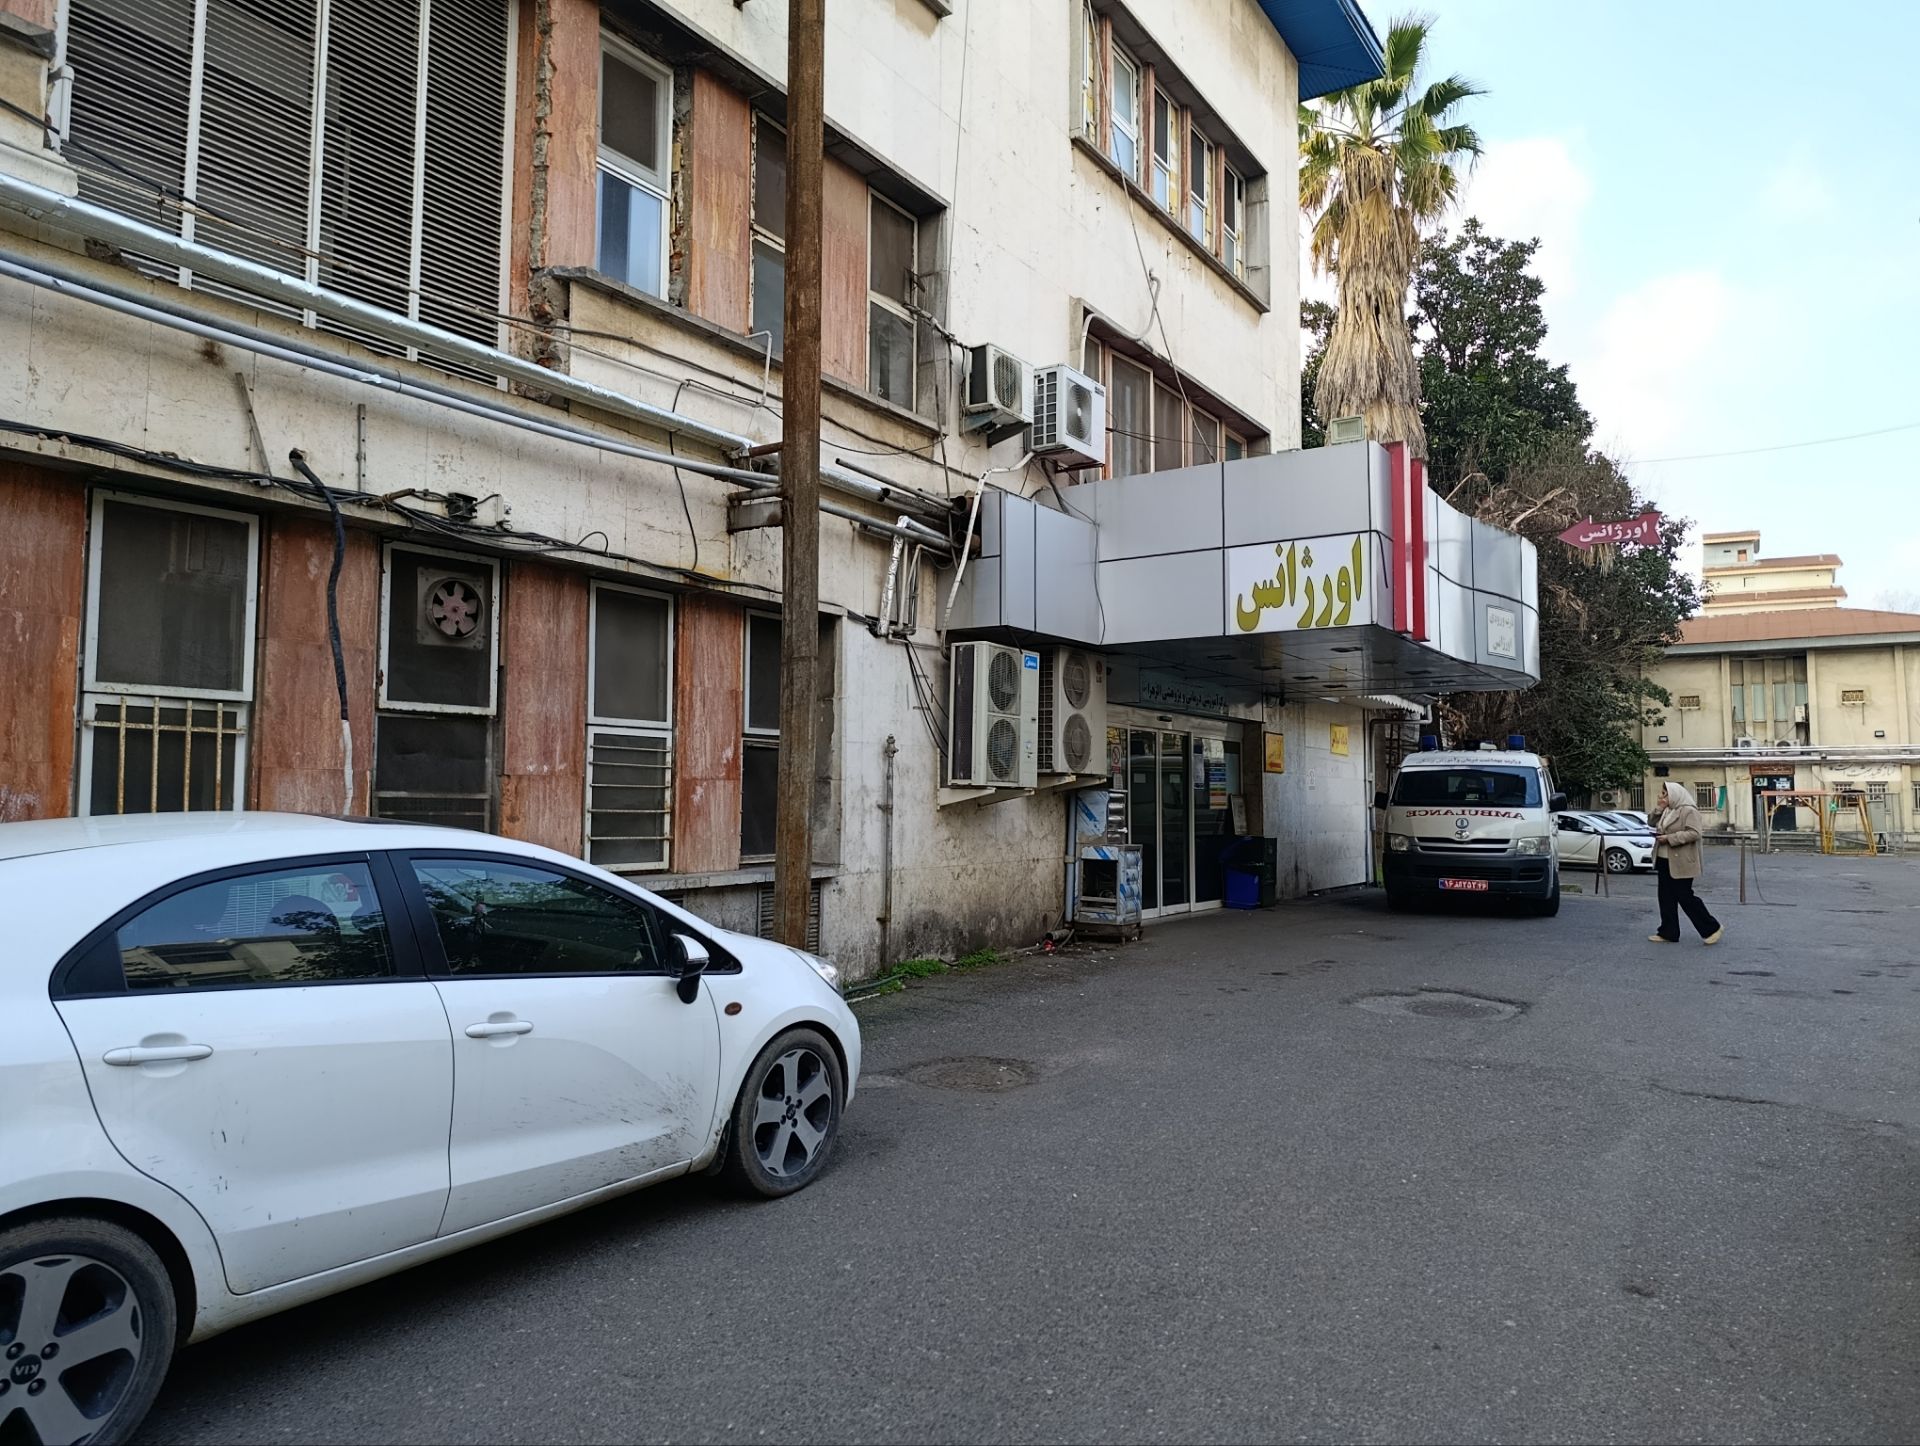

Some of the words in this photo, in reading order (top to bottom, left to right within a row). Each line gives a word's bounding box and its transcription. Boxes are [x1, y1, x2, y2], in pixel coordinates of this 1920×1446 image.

[1579, 520, 1648, 542] اورژانس
[1237, 534, 1362, 632] اورژانس
[15, 1363, 40, 1376] KIA
